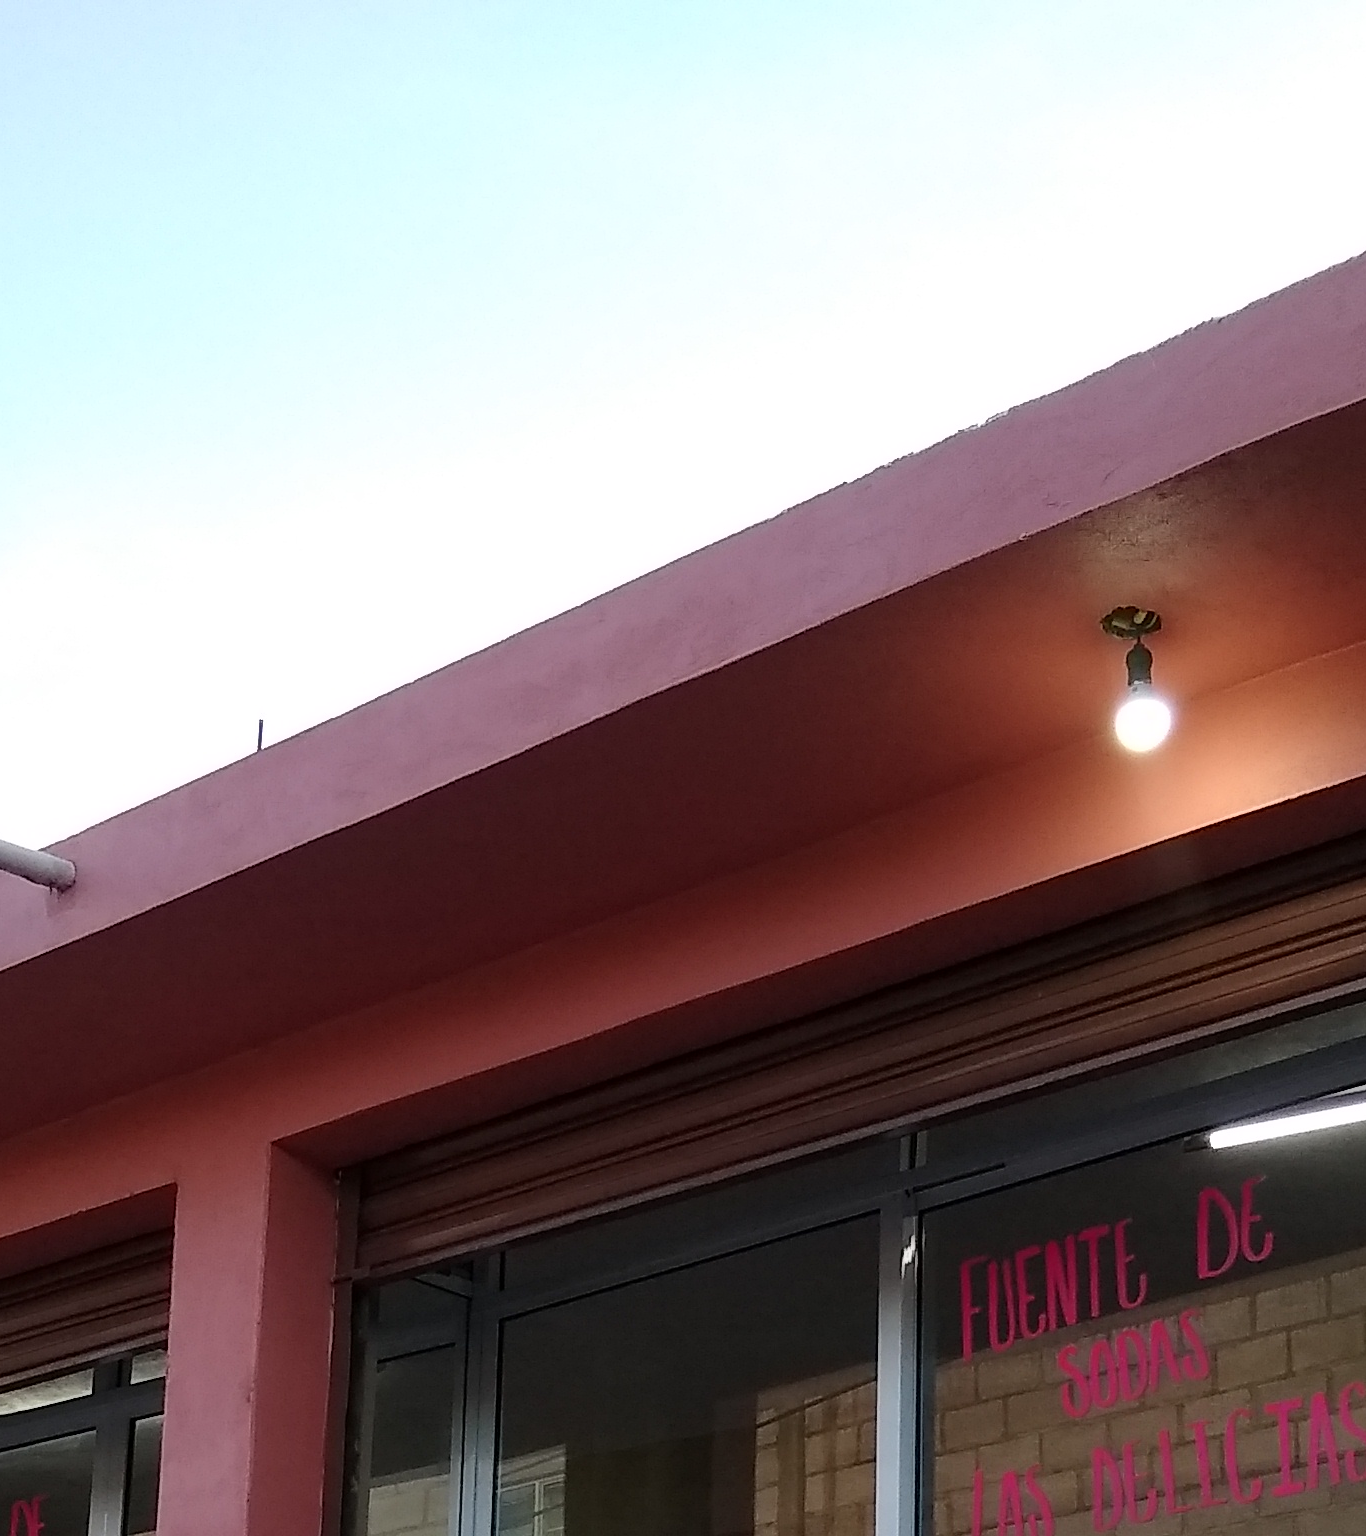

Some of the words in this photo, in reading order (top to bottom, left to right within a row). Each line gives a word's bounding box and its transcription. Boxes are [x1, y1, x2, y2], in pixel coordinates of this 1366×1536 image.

[960, 1218, 1147, 1361] FUENTE
[1197, 1175, 1274, 1279] DE
[1056, 1307, 1211, 1418] SODAS
